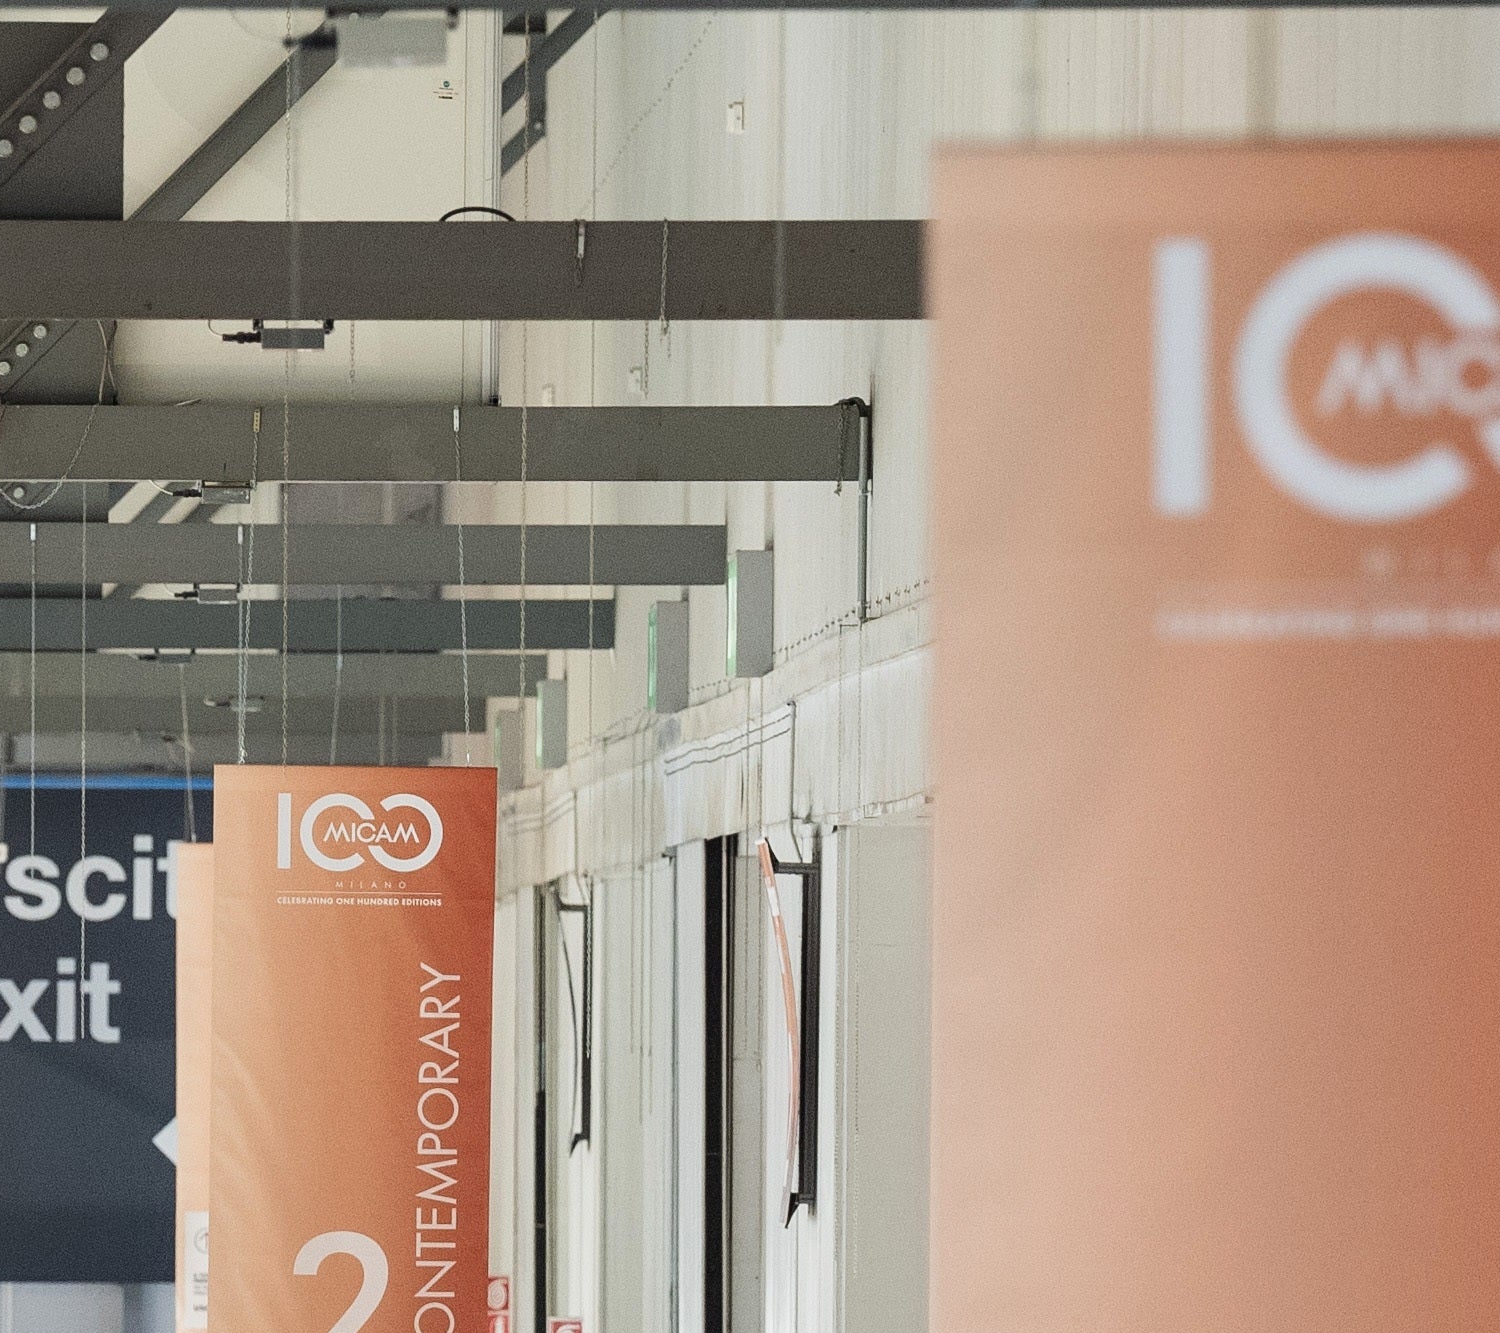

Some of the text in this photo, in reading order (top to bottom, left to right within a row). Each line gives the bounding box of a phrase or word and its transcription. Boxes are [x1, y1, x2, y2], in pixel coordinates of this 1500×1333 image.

[323, 822, 420, 844] MICAM
[335, 881, 407, 890] MILANO
[276, 896, 442, 908] CELEBRATING ONE HUNDRED EDITIONS
